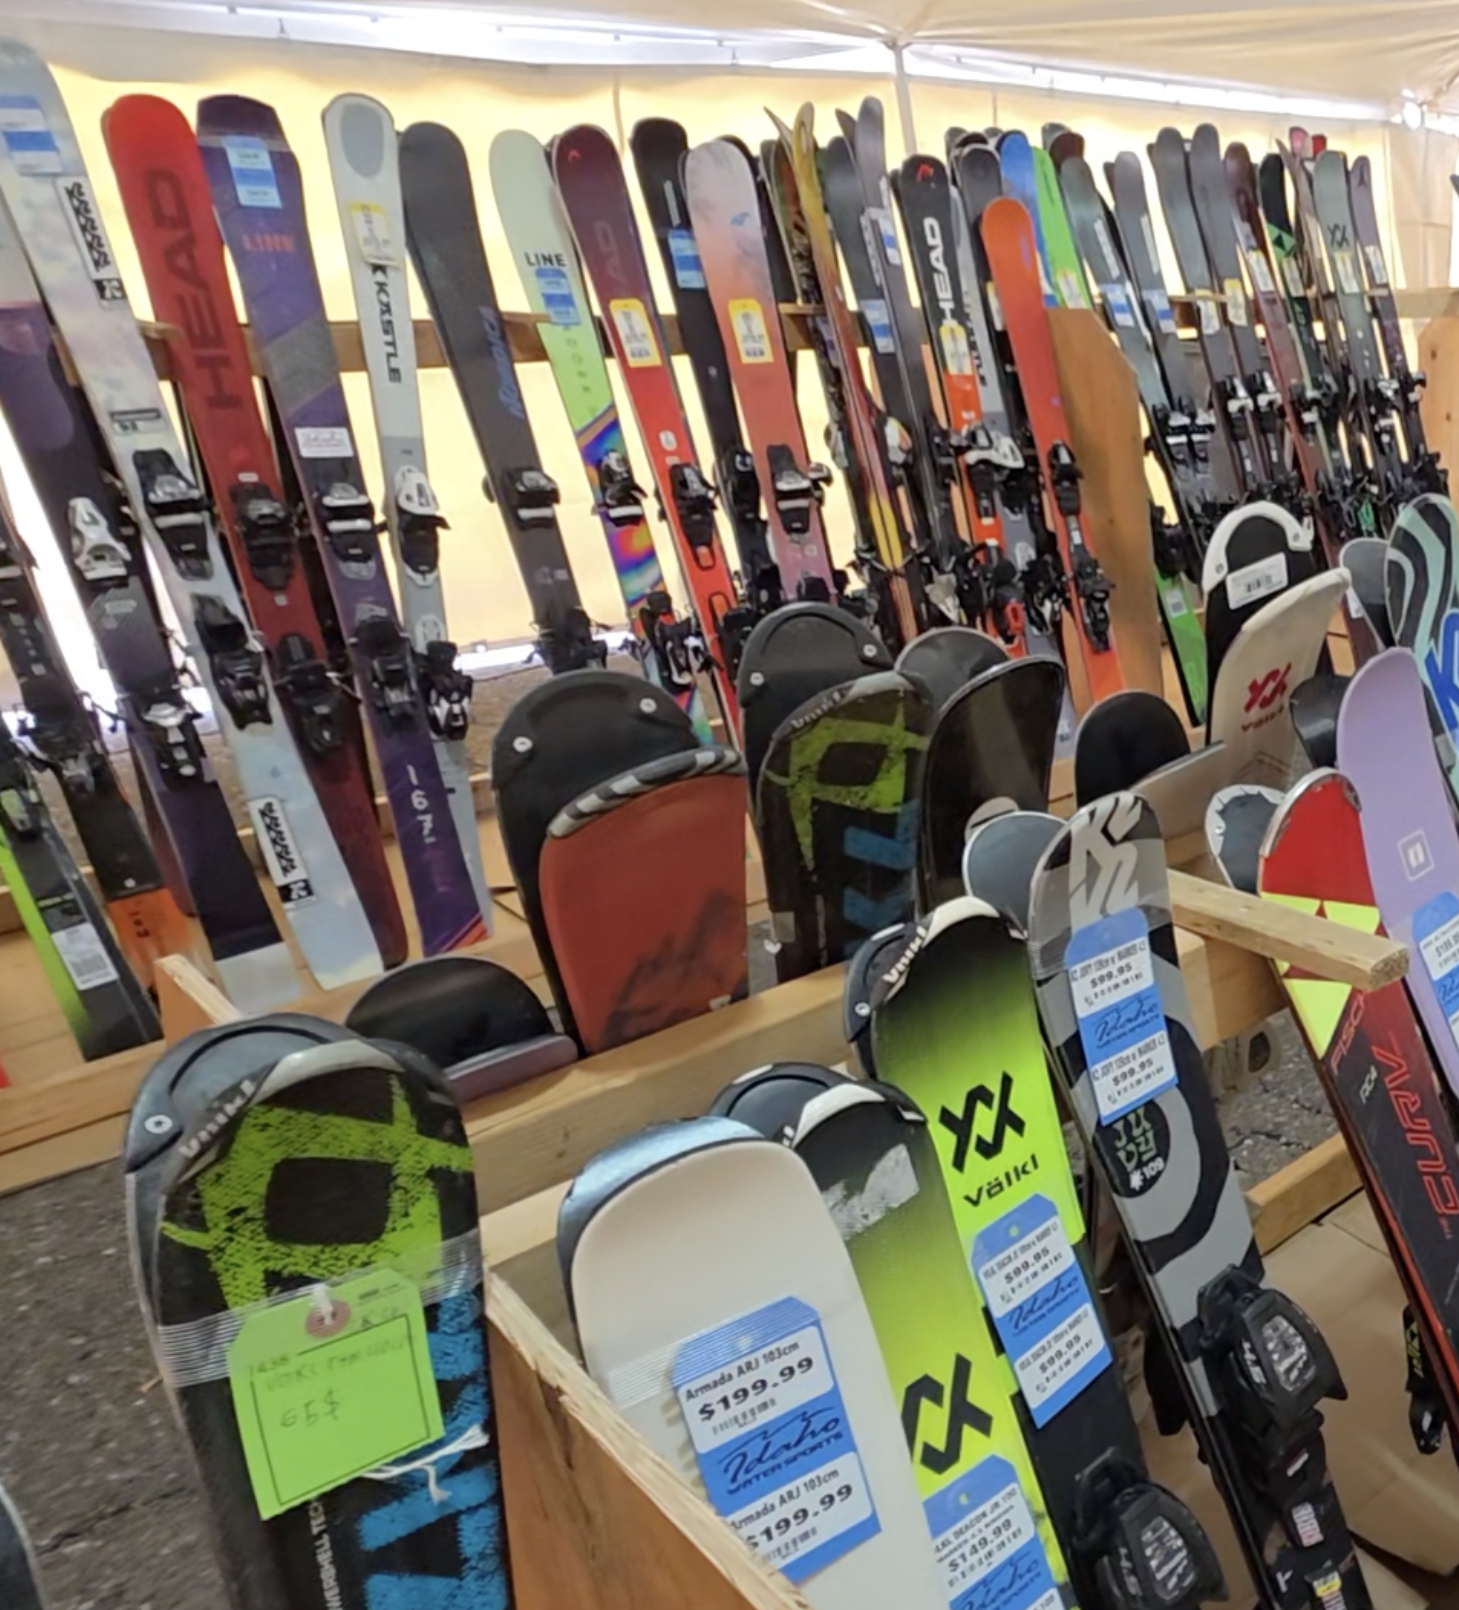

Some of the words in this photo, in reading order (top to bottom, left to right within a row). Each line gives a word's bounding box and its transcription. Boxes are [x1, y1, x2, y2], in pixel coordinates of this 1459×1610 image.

[146, 168, 243, 409] HEAD
[524, 251, 567, 268] LINE
[923, 217, 958, 326] HEAD
[1331, 989, 1366, 1077] FISC
[685, 1370, 734, 1402] Armada
[736, 1358, 761, 1379] ARJ
[762, 1341, 801, 1365] 103cm
[698, 1356, 814, 1423] $199.99
[720, 1408, 841, 1486] Idaho
[746, 1483, 853, 1552] $199.99
[778, 1486, 802, 1507] ARJ
[803, 1468, 840, 1494] 103cm
[948, 1518, 1013, 1573] $149.99
